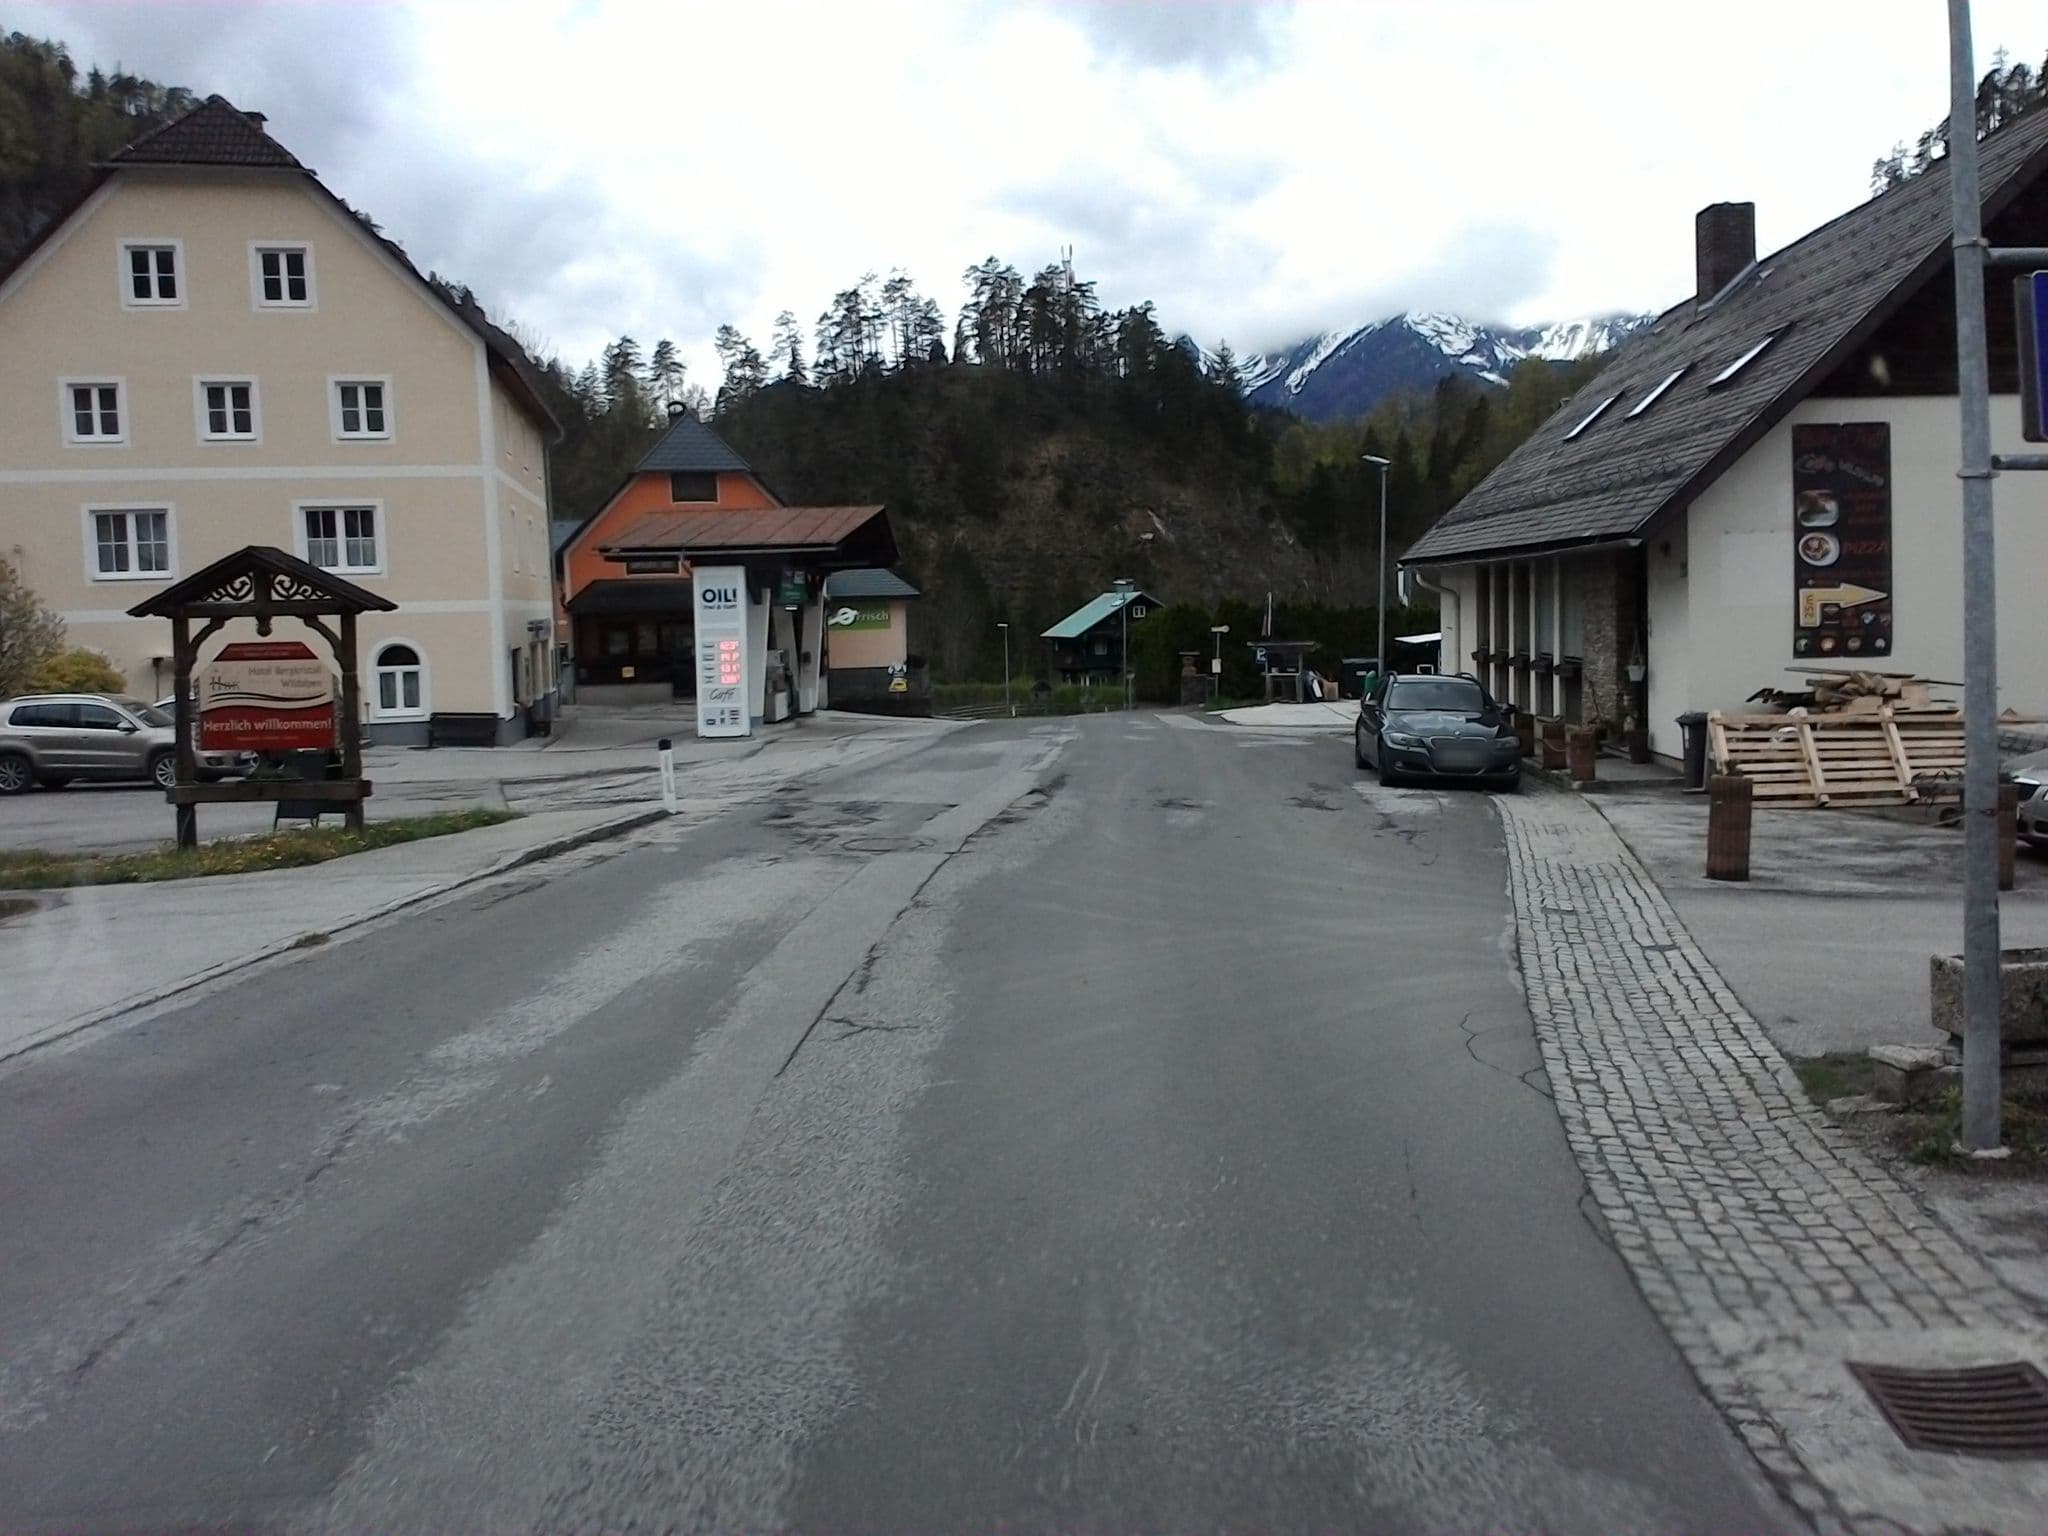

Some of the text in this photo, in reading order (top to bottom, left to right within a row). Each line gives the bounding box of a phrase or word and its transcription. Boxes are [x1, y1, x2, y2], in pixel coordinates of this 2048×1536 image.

[702, 588, 737, 603] OIL!
[1256, 647, 1266, 661] P
[203, 718, 332, 731] Herzlich willkommen!
